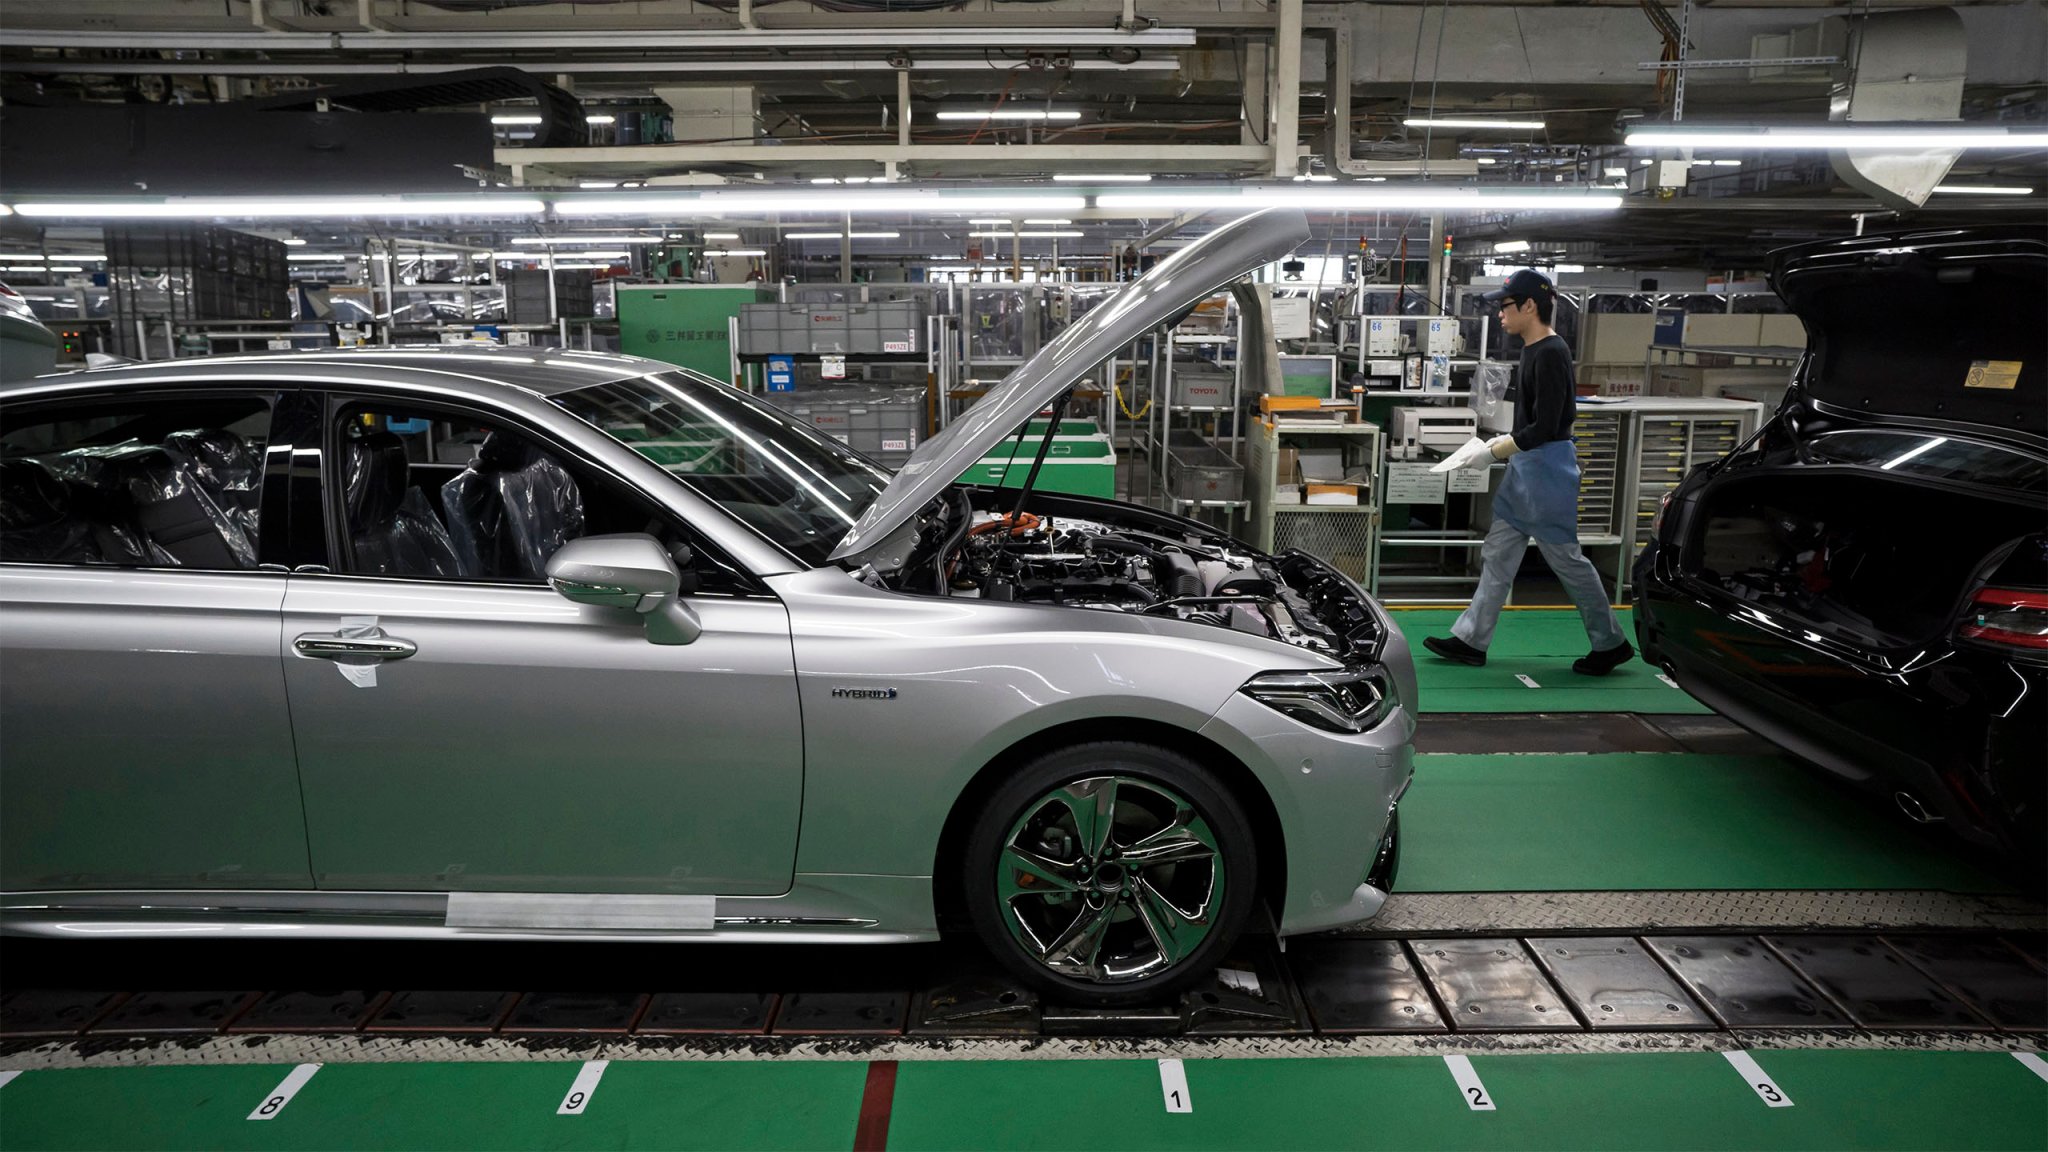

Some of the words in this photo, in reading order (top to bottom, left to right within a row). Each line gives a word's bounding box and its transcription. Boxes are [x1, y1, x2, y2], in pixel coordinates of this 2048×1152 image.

[1372, 322, 1382, 331] 66
[1431, 322, 1441, 332] 65
[885, 343, 907, 351] P493ZE
[832, 688, 887, 699] HYBRID
[566, 1092, 585, 1110] 9
[1171, 1090, 1181, 1108] 1
[1467, 1087, 1488, 1105] 2
[1757, 1083, 1782, 1102] 3
[259, 1096, 285, 1115] 8
